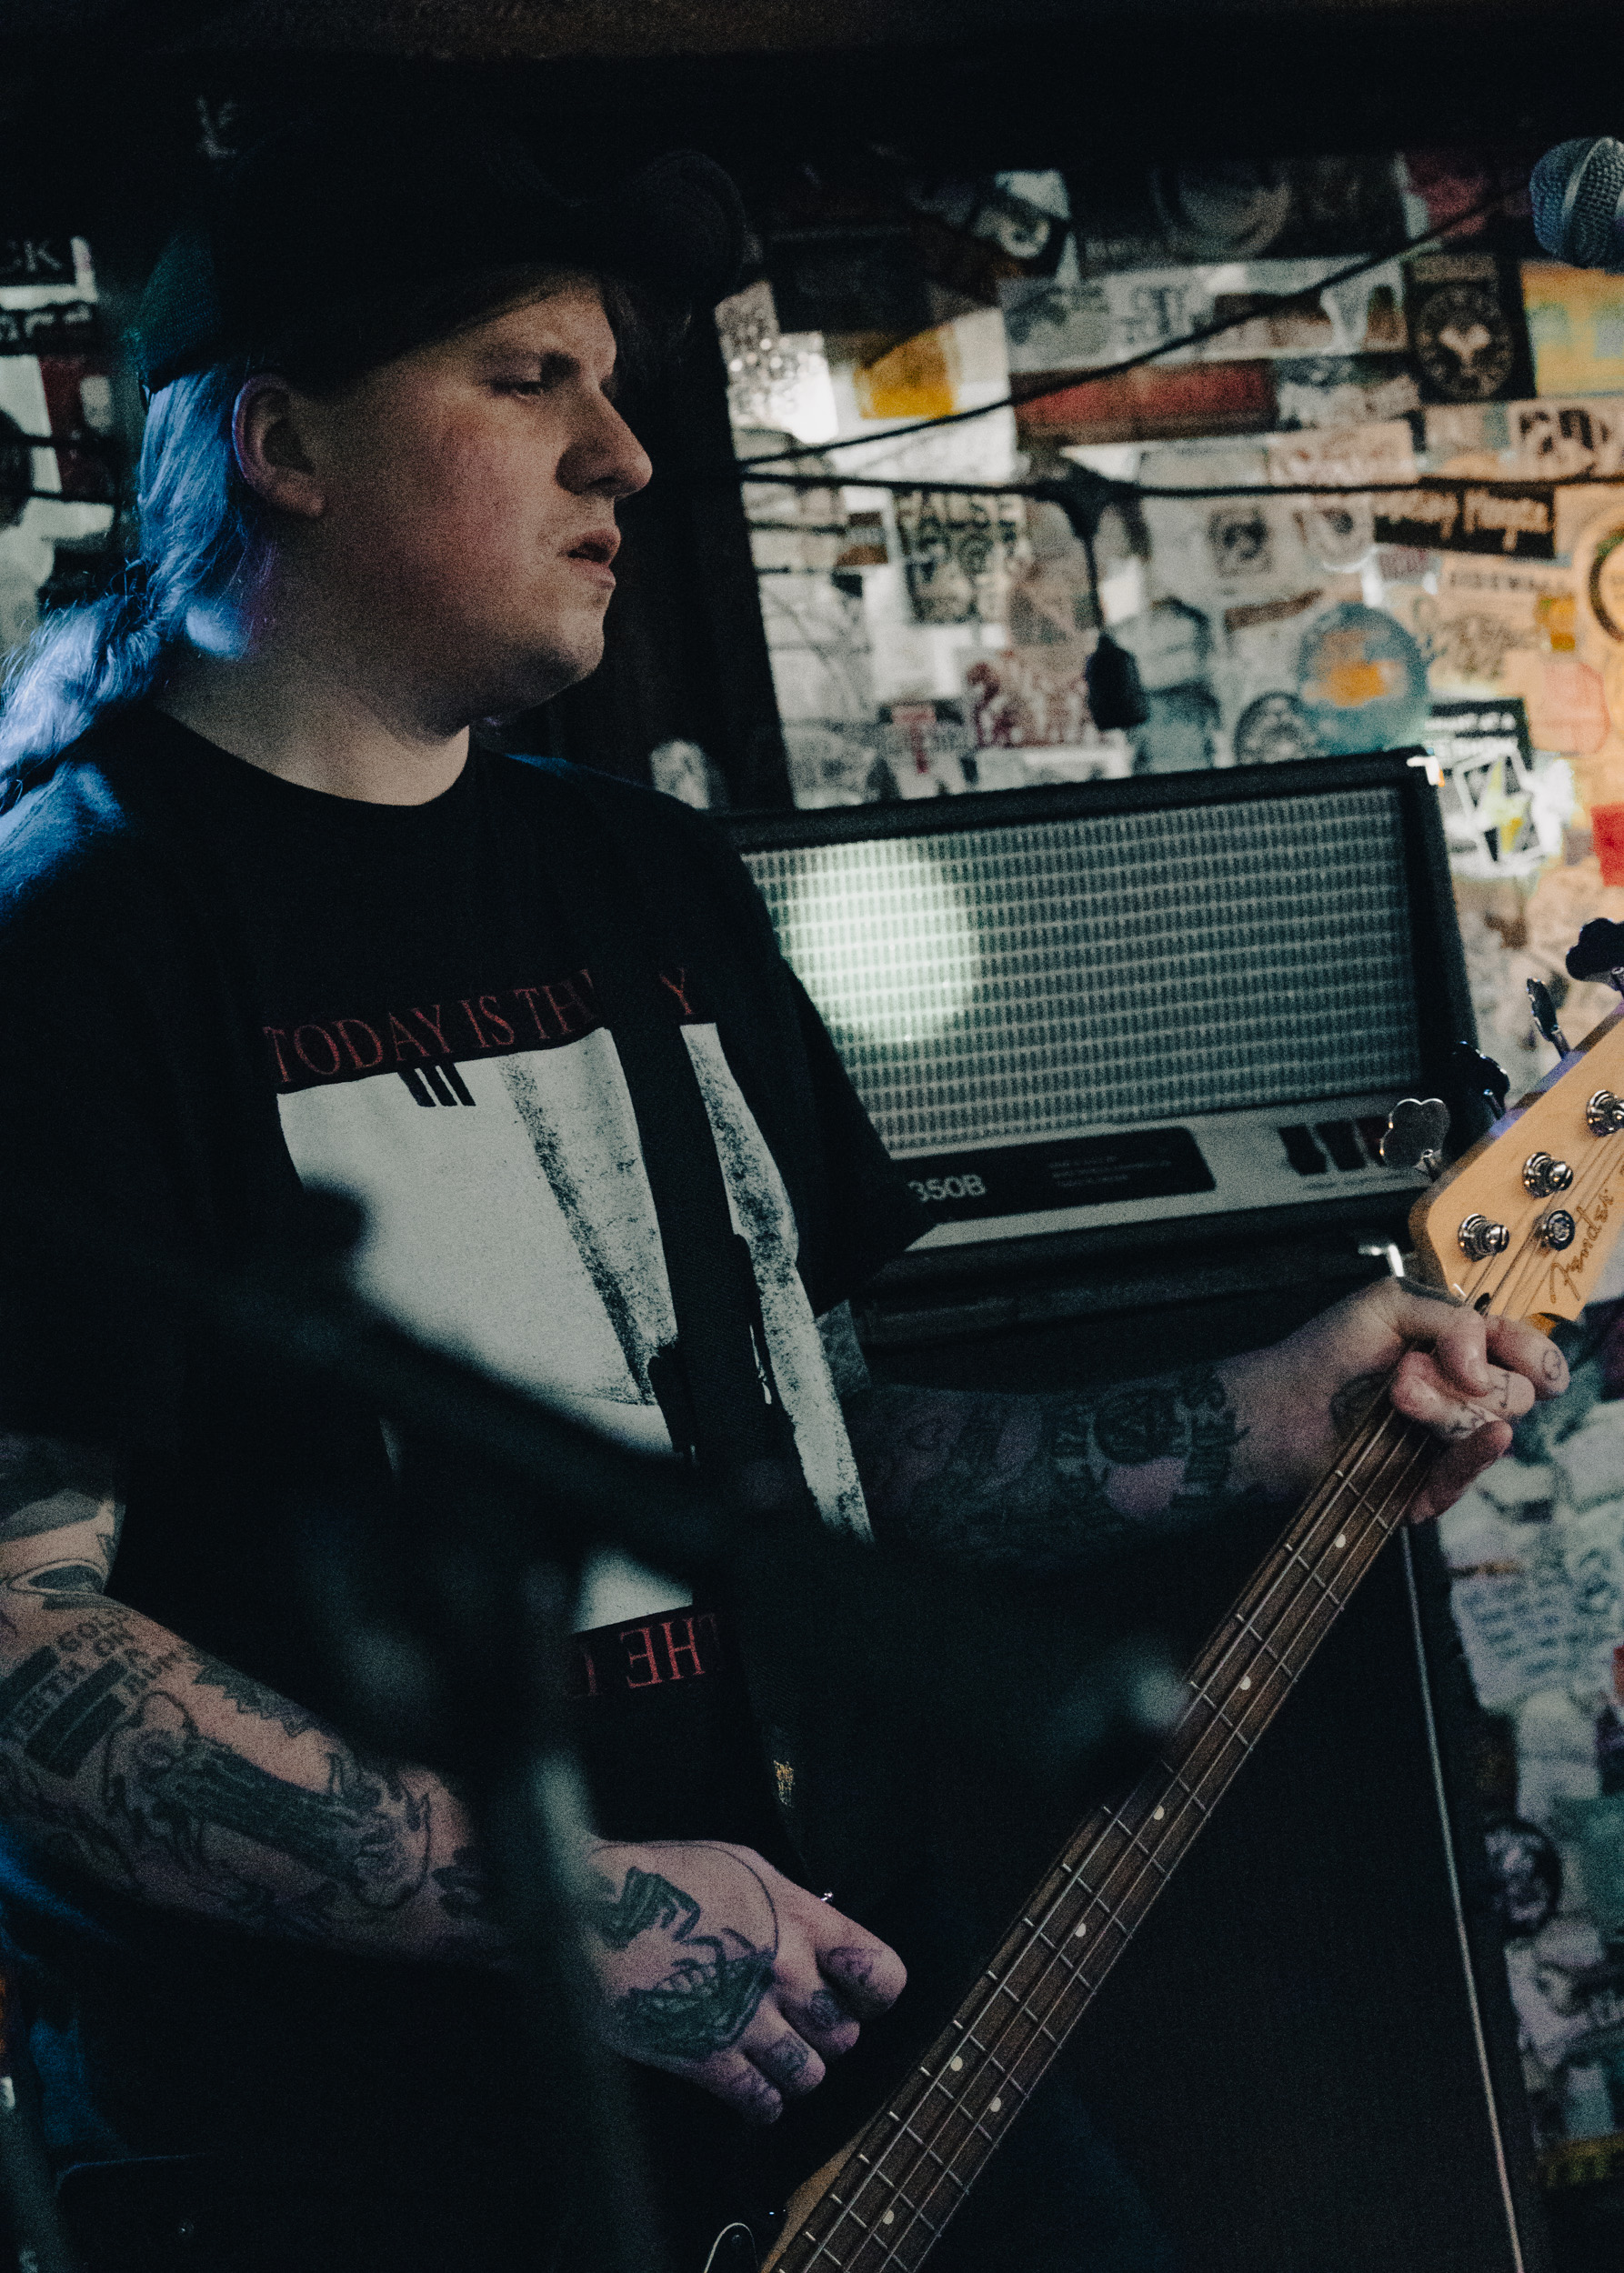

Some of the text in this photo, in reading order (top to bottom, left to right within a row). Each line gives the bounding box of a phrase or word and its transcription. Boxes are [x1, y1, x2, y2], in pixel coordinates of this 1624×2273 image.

[263, 1004, 452, 1083] TODAY
[461, 996, 515, 1048] IS
[513, 969, 596, 1040] TH
[1549, 1191, 1614, 1304] Fender
